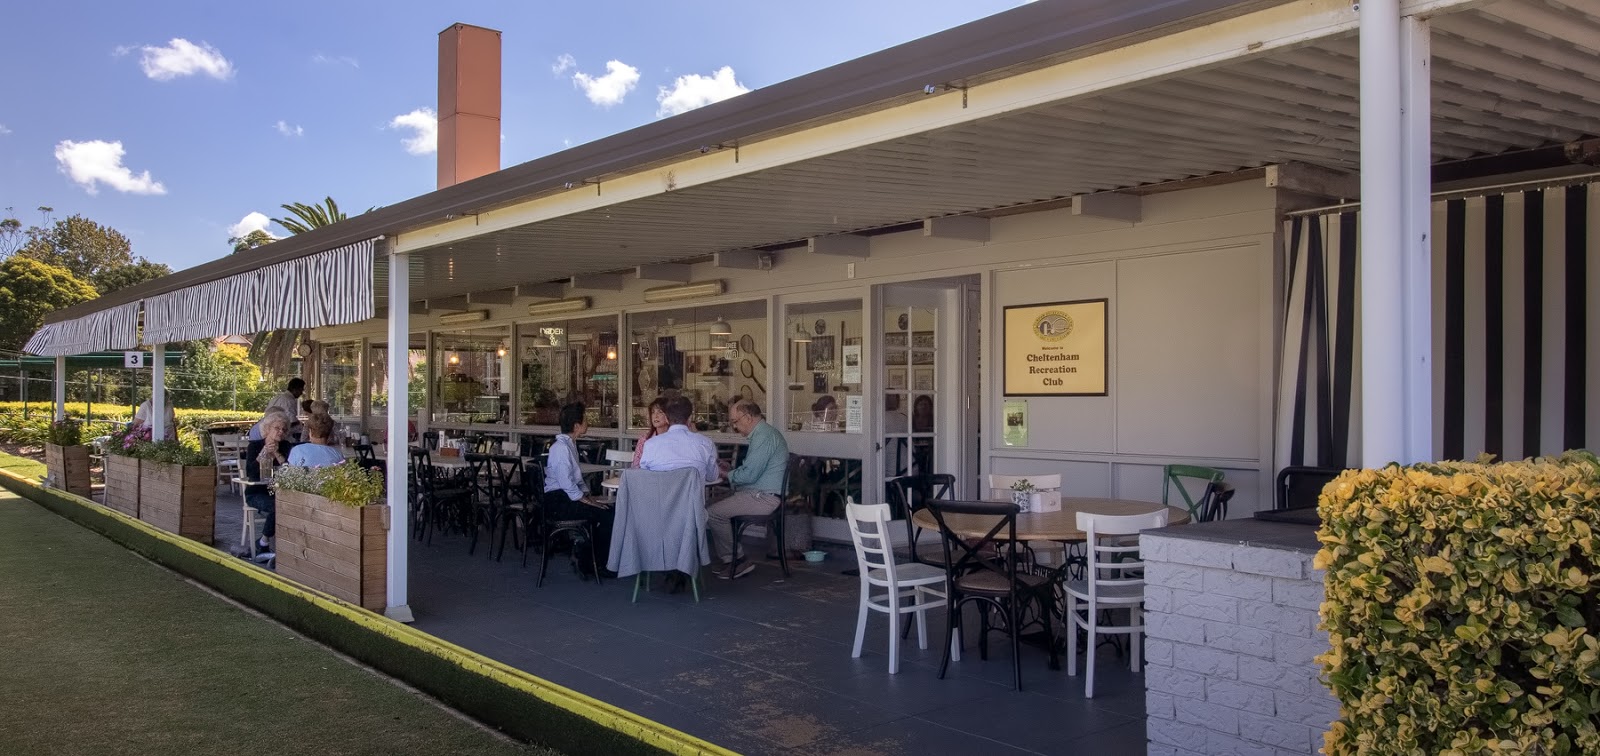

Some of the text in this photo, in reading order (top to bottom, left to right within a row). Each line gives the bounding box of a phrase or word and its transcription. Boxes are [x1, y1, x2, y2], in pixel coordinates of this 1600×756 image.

[131, 354, 138, 364] 3
[1026, 353, 1080, 362] Cheltenham
[1029, 365, 1077, 374] Recreation
[1043, 377, 1063, 386] Club
